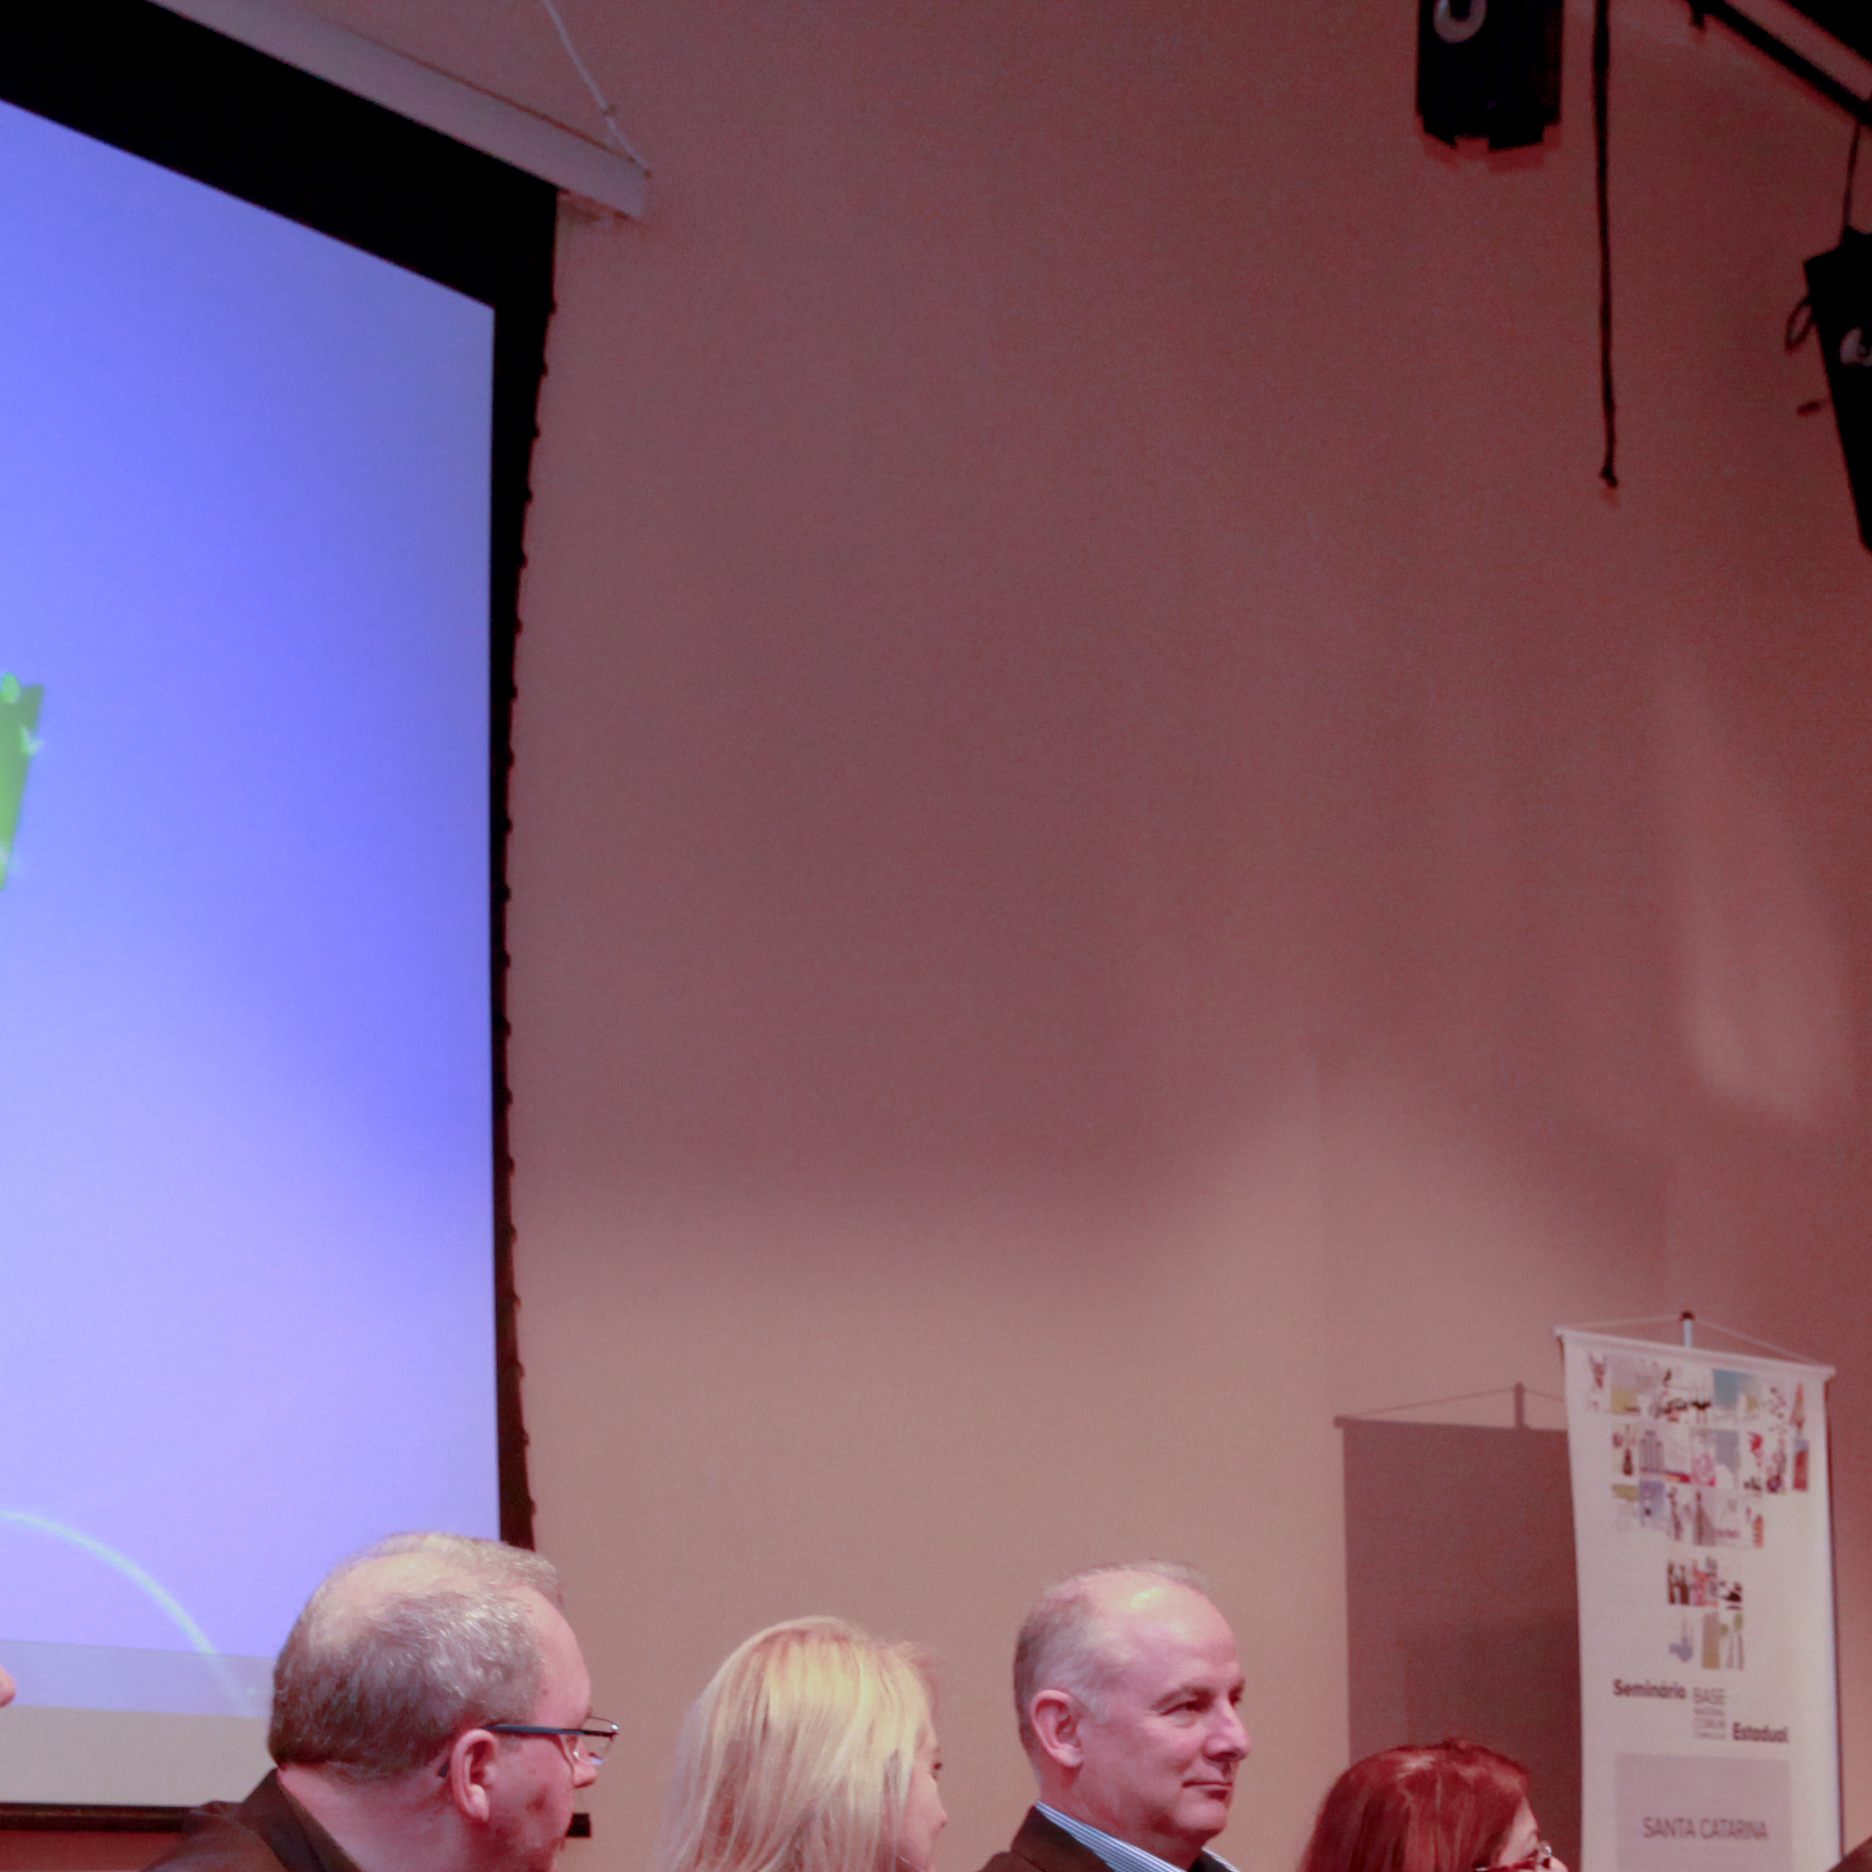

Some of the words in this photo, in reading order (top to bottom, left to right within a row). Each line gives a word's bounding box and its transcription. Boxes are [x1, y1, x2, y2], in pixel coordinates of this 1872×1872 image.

[1733, 1721, 1789, 1743] Estadual
[1643, 1816, 1695, 1839] SANTA
[1700, 1817, 1768, 1841] CATARINA
